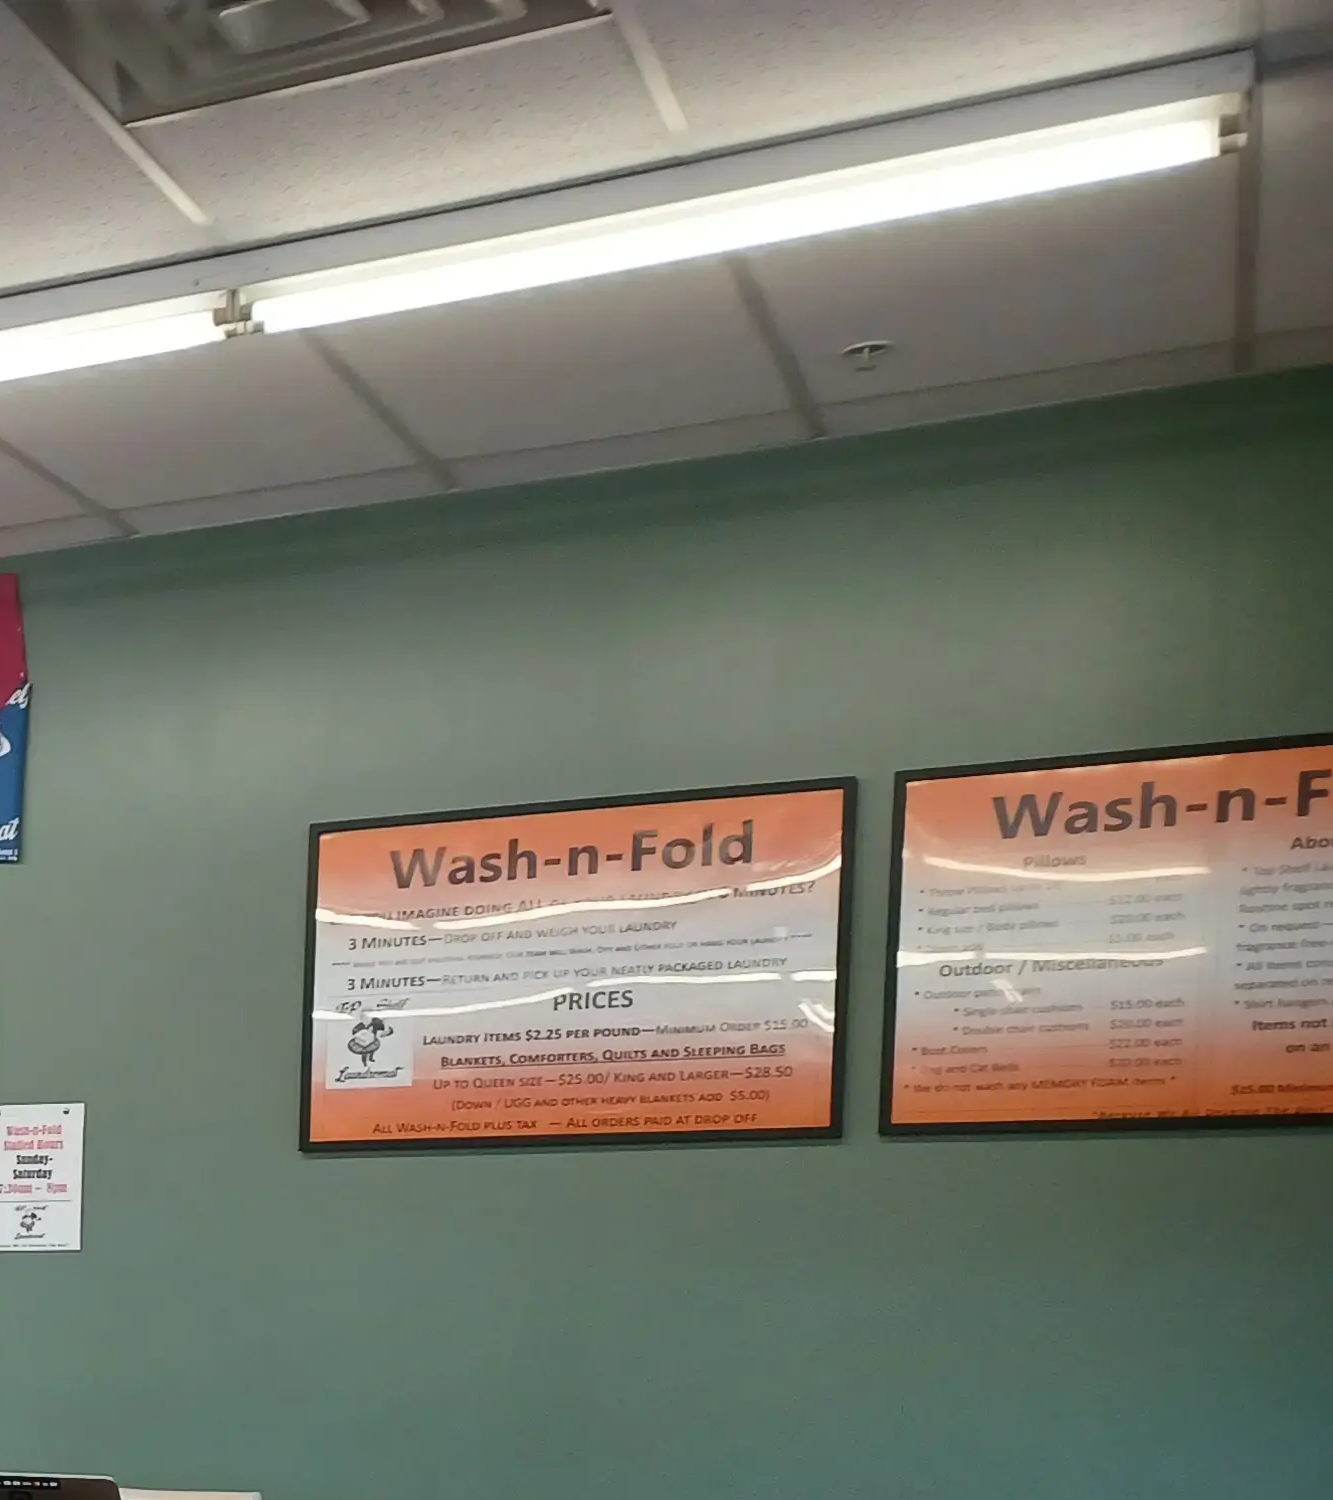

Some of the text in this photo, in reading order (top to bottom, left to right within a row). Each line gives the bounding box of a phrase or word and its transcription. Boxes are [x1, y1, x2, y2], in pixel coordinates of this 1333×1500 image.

[390, 819, 754, 889] Wash-n-Fold
[1023, 853, 1087, 868] Pillows
[397, 906, 459, 921] IMAGINE
[464, 902, 513, 916] DOING
[348, 938, 357, 950] 3
[481, 930, 503, 942] OFF
[506, 929, 533, 941] AND
[536, 926, 579, 939] WEIGH
[619, 920, 678, 933] LAUNDRY
[347, 978, 356, 991] 3
[493, 972, 519, 983] AND
[553, 969, 570, 980] UP
[574, 966, 608, 978] YOUR
[611, 964, 655, 976] NEATLY
[658, 960, 724, 973] PACKAGED
[727, 957, 788, 970] LAUNDRY
[939, 961, 1014, 977] Outdoor
[553, 989, 634, 1011] PRICES
[423, 1034, 480, 1047] LAUNDRY
[484, 1031, 522, 1043] ITEMS
[525, 1028, 563, 1043] $2.25
[566, 1028, 590, 1039] PER
[719, 1020, 761, 1033] ORDER
[1300, 1017, 1328, 1029] not
[441, 1043, 786, 1068] BLANKETS, COMFORTERS, QUILTS AND SLEEPING BAGS
[434, 1079, 452, 1090] UP
[455, 1079, 469, 1090] TO
[473, 1077, 515, 1090] QUEEN
[613, 1071, 645, 1084] KING
[648, 1071, 676, 1082] AND
[1031, 1078, 1088, 1090] MEMORY
[451, 1089, 771, 1112] (DOWN UGG AND OTHER HEAVY BLANKETS ADD $5.00)
[373, 1112, 758, 1135] ALL WASH-N-FOLD PLUS TAX ALL ORDERS PAID AT DROP OFF
[13, 1169, 53, 1180] Saturday
